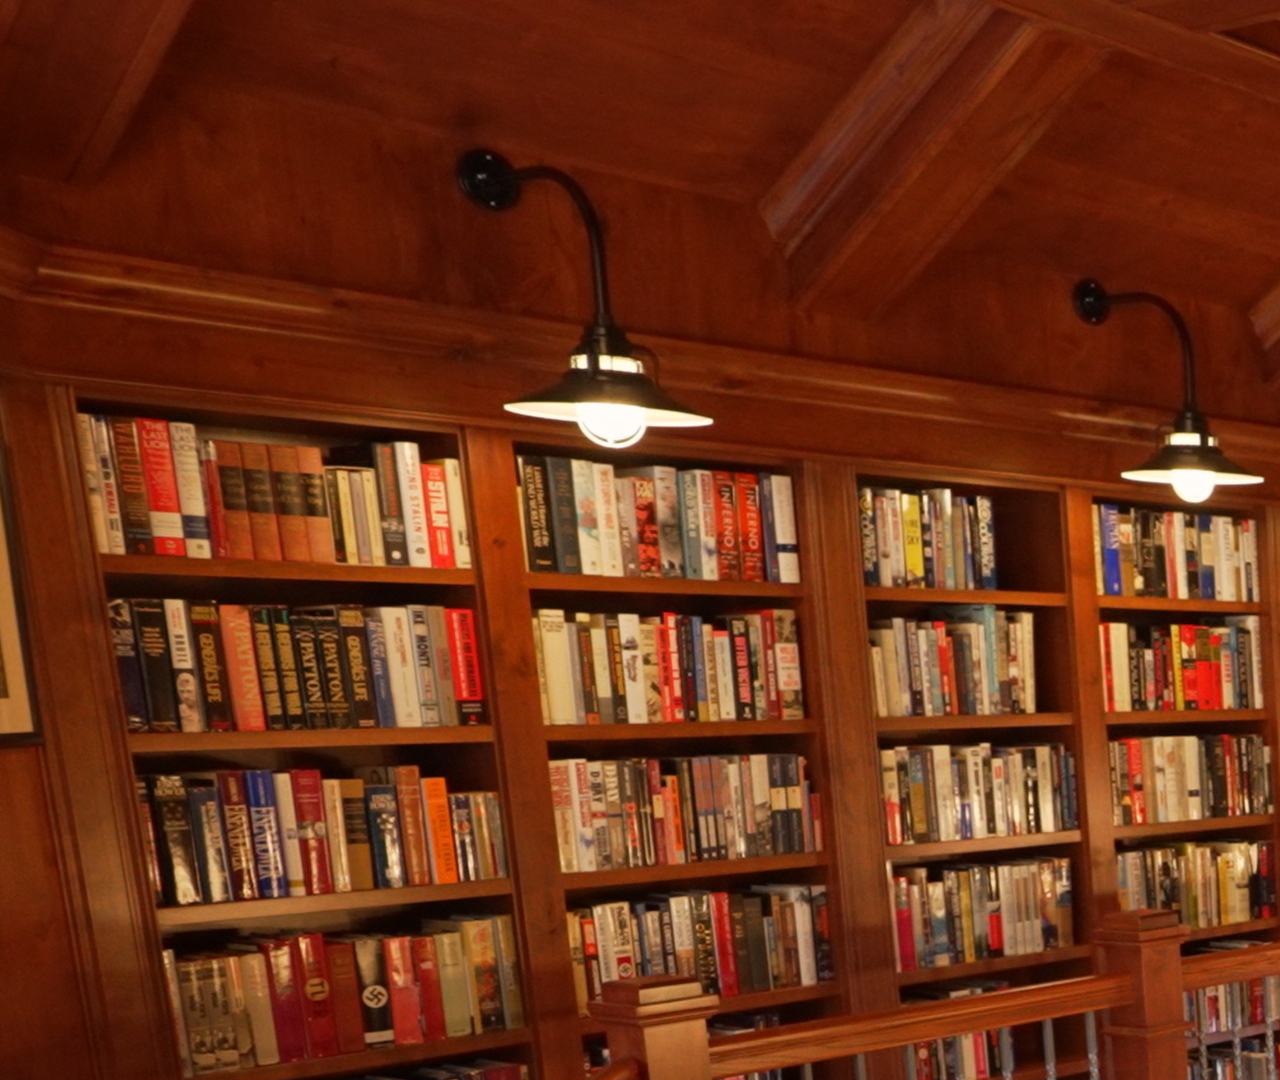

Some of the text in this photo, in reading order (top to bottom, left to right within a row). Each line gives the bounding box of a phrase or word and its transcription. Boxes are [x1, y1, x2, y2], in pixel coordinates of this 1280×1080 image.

[114, 422, 144, 493] WARLORD
[410, 495, 423, 533] STALIN
[427, 481, 449, 528] STALIN
[720, 488, 735, 548] INFERNO
[745, 490, 758, 549] INFERNO
[979, 523, 992, 577] COURAGE
[234, 631, 257, 702] PATTON
[300, 640, 323, 702] PATTON
[323, 640, 346, 702] PATTON
[416, 635, 431, 668] MONTY
[735, 636, 752, 703] BITTER VICTORY
[206, 683, 223, 703] LIFE
[353, 682, 369, 701] LIFE
